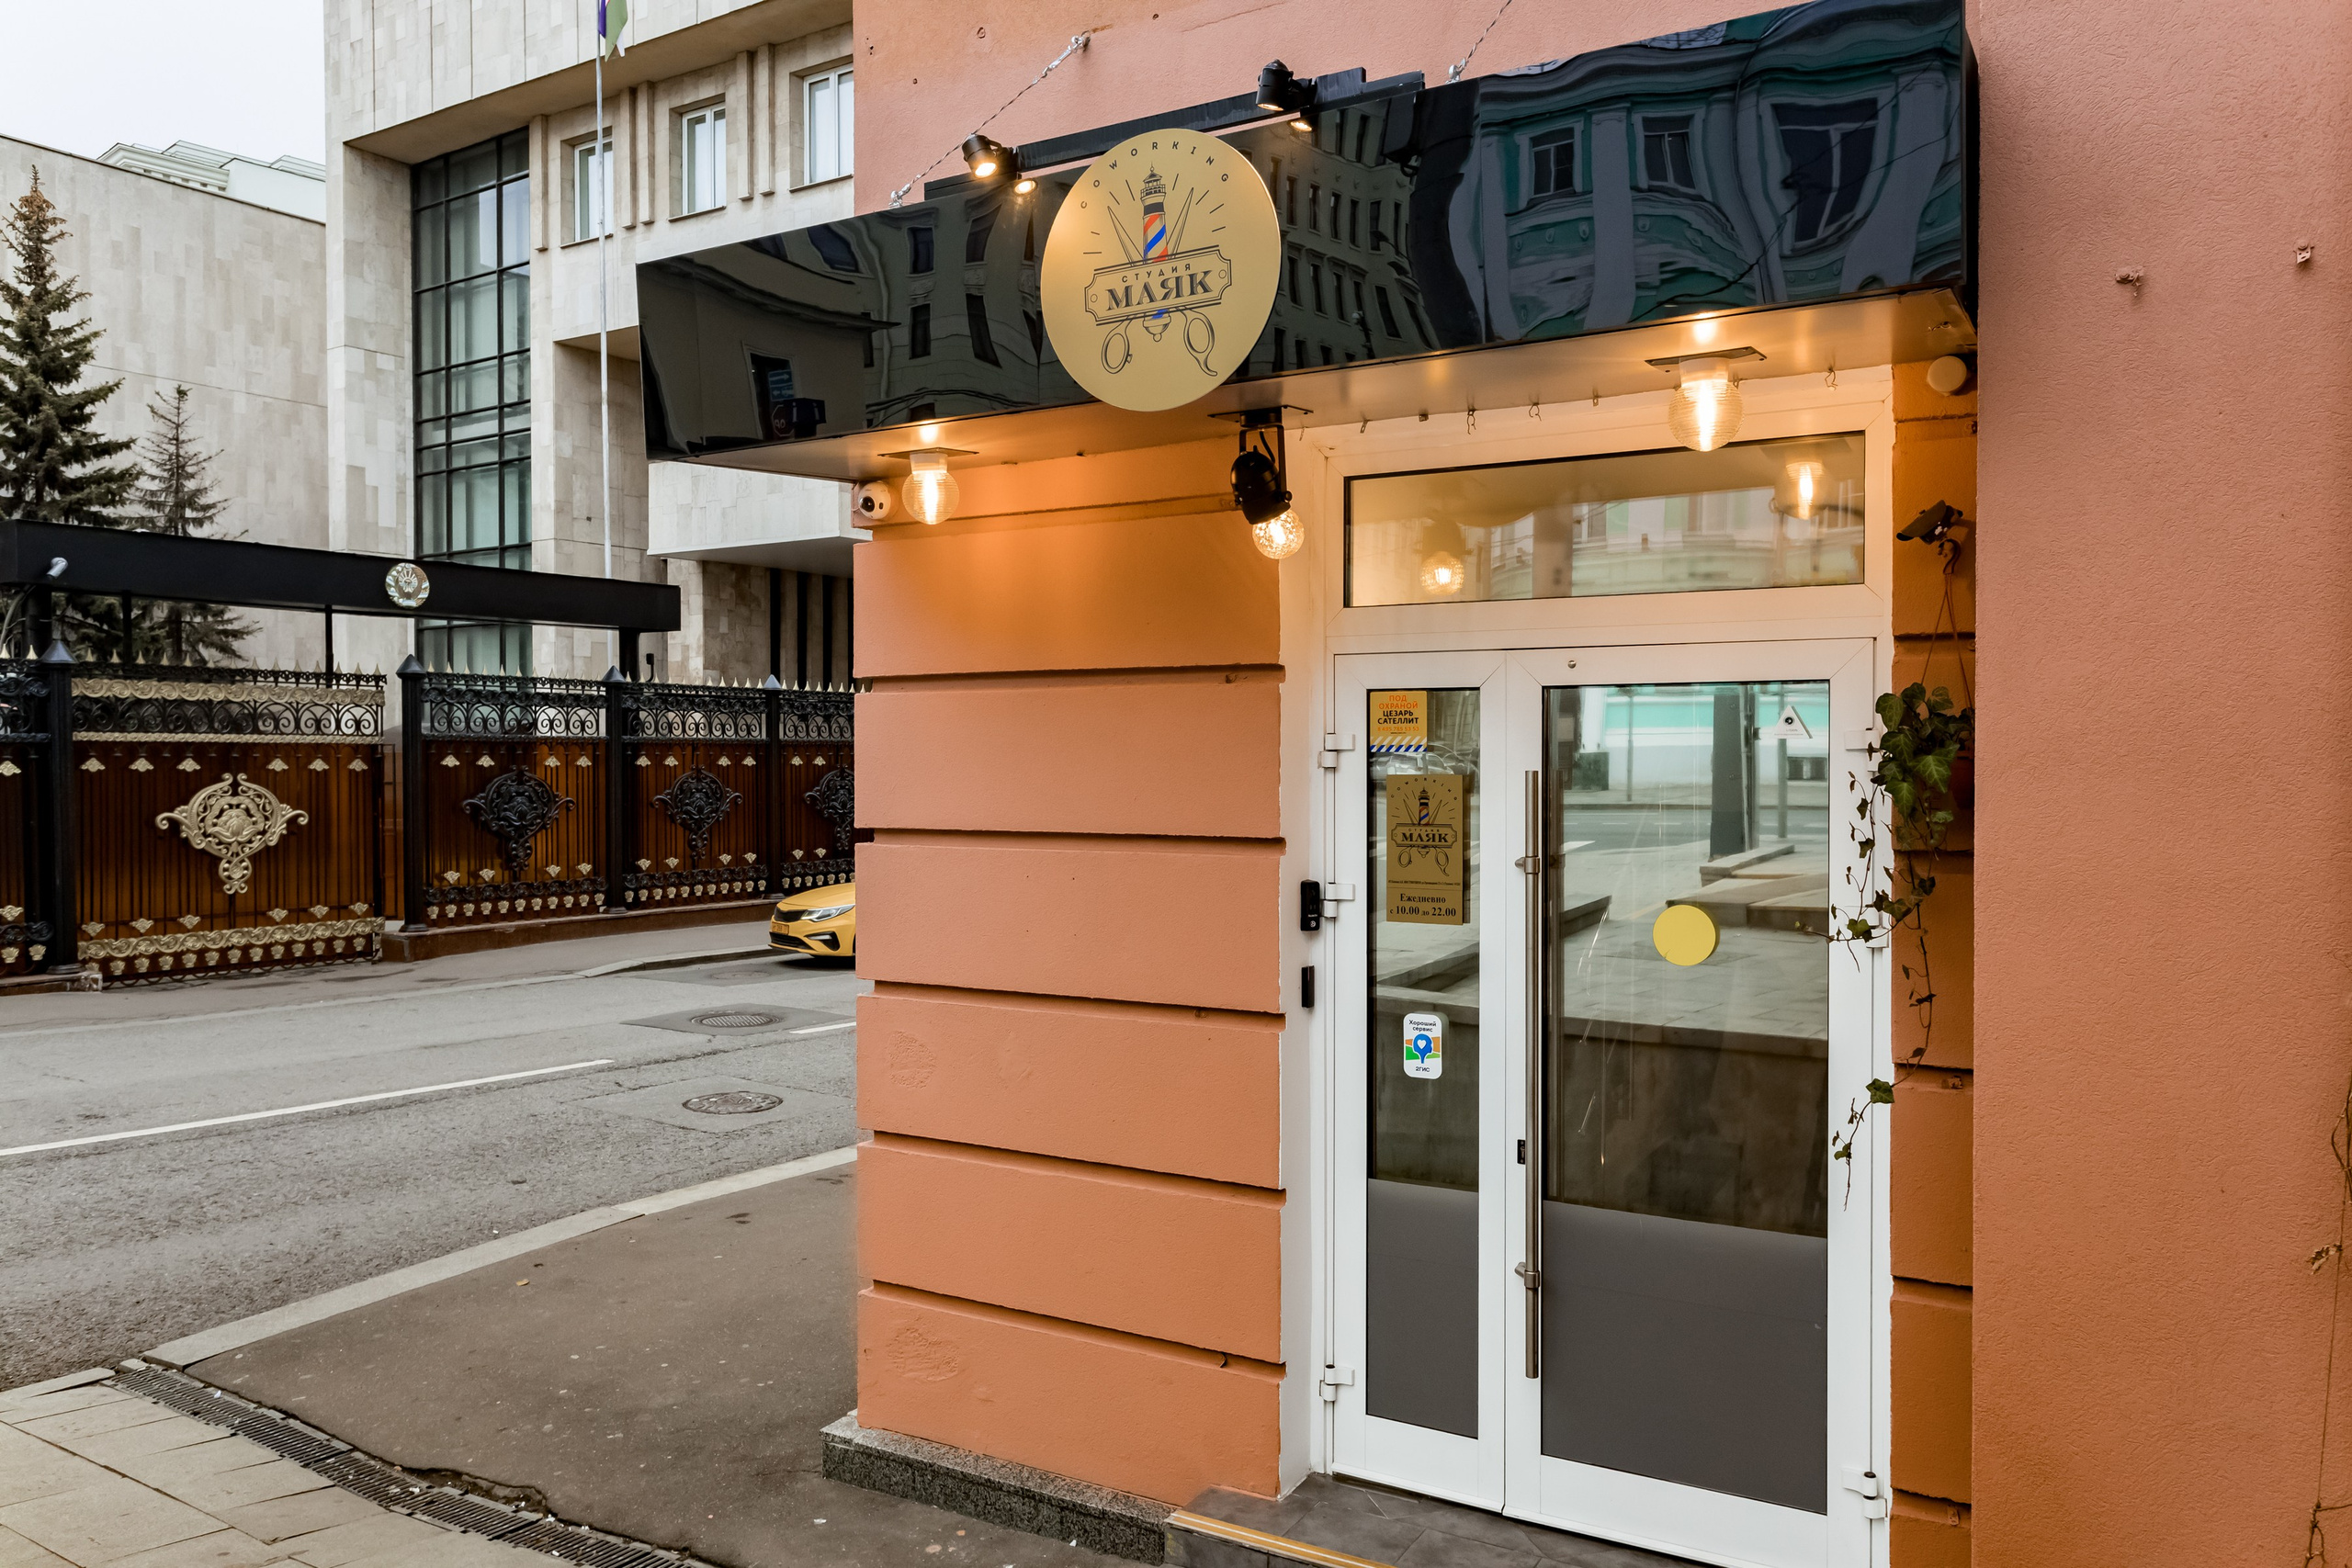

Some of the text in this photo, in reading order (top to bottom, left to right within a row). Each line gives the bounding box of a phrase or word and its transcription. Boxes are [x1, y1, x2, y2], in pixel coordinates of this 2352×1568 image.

[1080, 141, 1229, 209] COWORKING
[1121, 263, 1191, 283] СТУДИЯ
[1105, 269, 1214, 311] МАЯК
[1378, 701, 1418, 709] ОХРАНОЙ
[1401, 832, 1449, 843] МАЯК
[1400, 893, 1446, 903] Ежедневно
[1396, 905, 1420, 915] 10.00
[1431, 907, 1456, 917] 22.00
